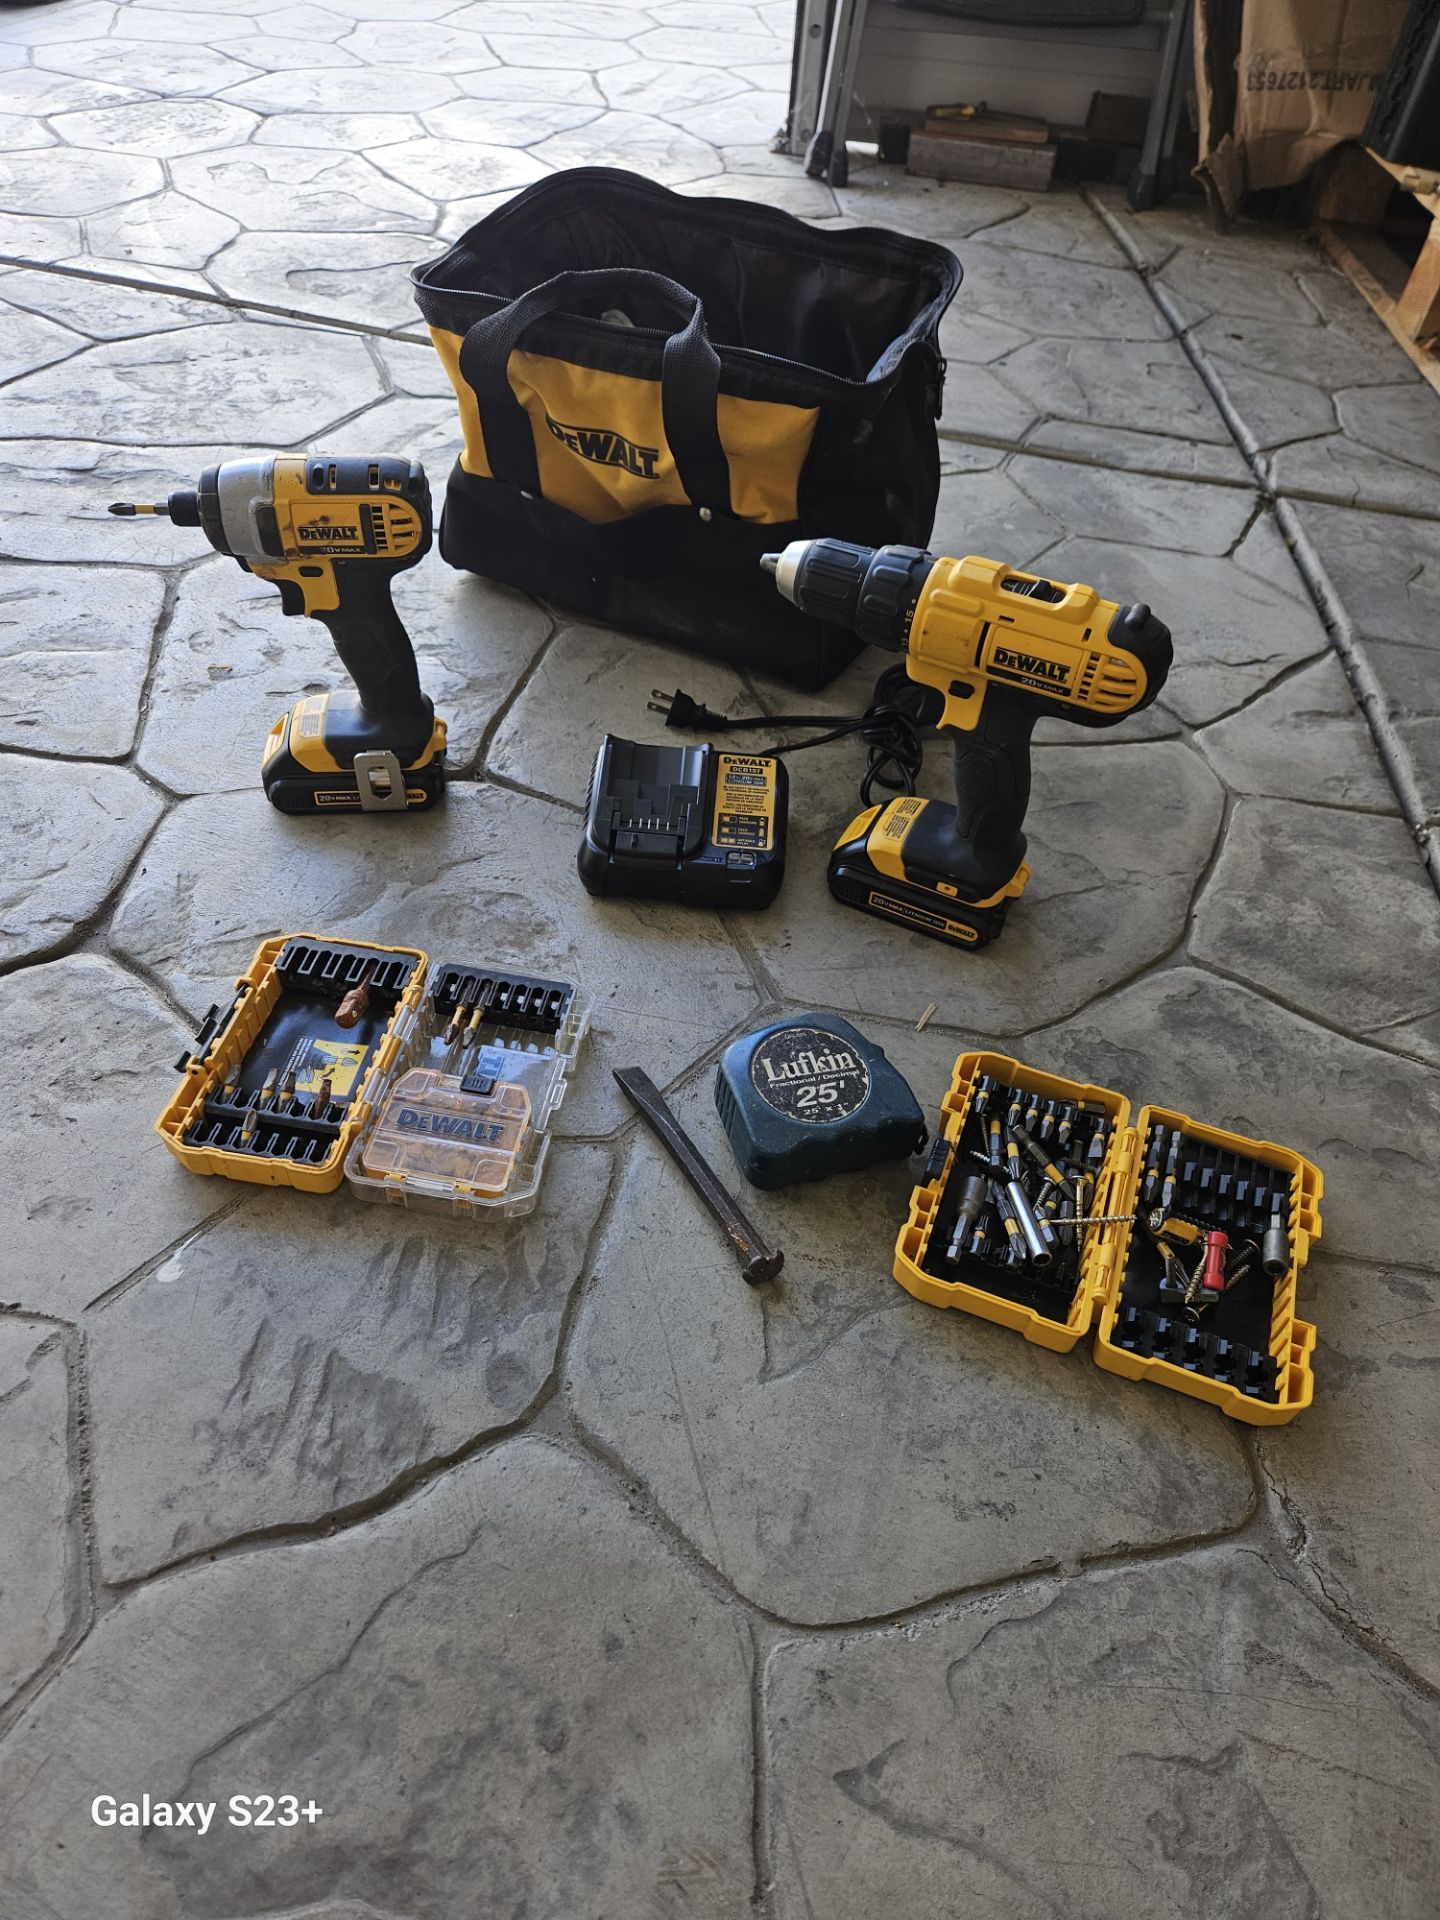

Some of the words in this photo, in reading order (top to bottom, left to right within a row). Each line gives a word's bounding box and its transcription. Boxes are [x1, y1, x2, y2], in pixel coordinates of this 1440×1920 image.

[298, 527, 358, 540] DEWALT
[994, 647, 1071, 684] DEWALT
[761, 1048, 857, 1082] Lufkin
[769, 1076, 817, 1089] Fractional
[822, 1069, 860, 1080] Decimal
[797, 1080, 846, 1108] 25'
[397, 1107, 504, 1142] DEWALT
